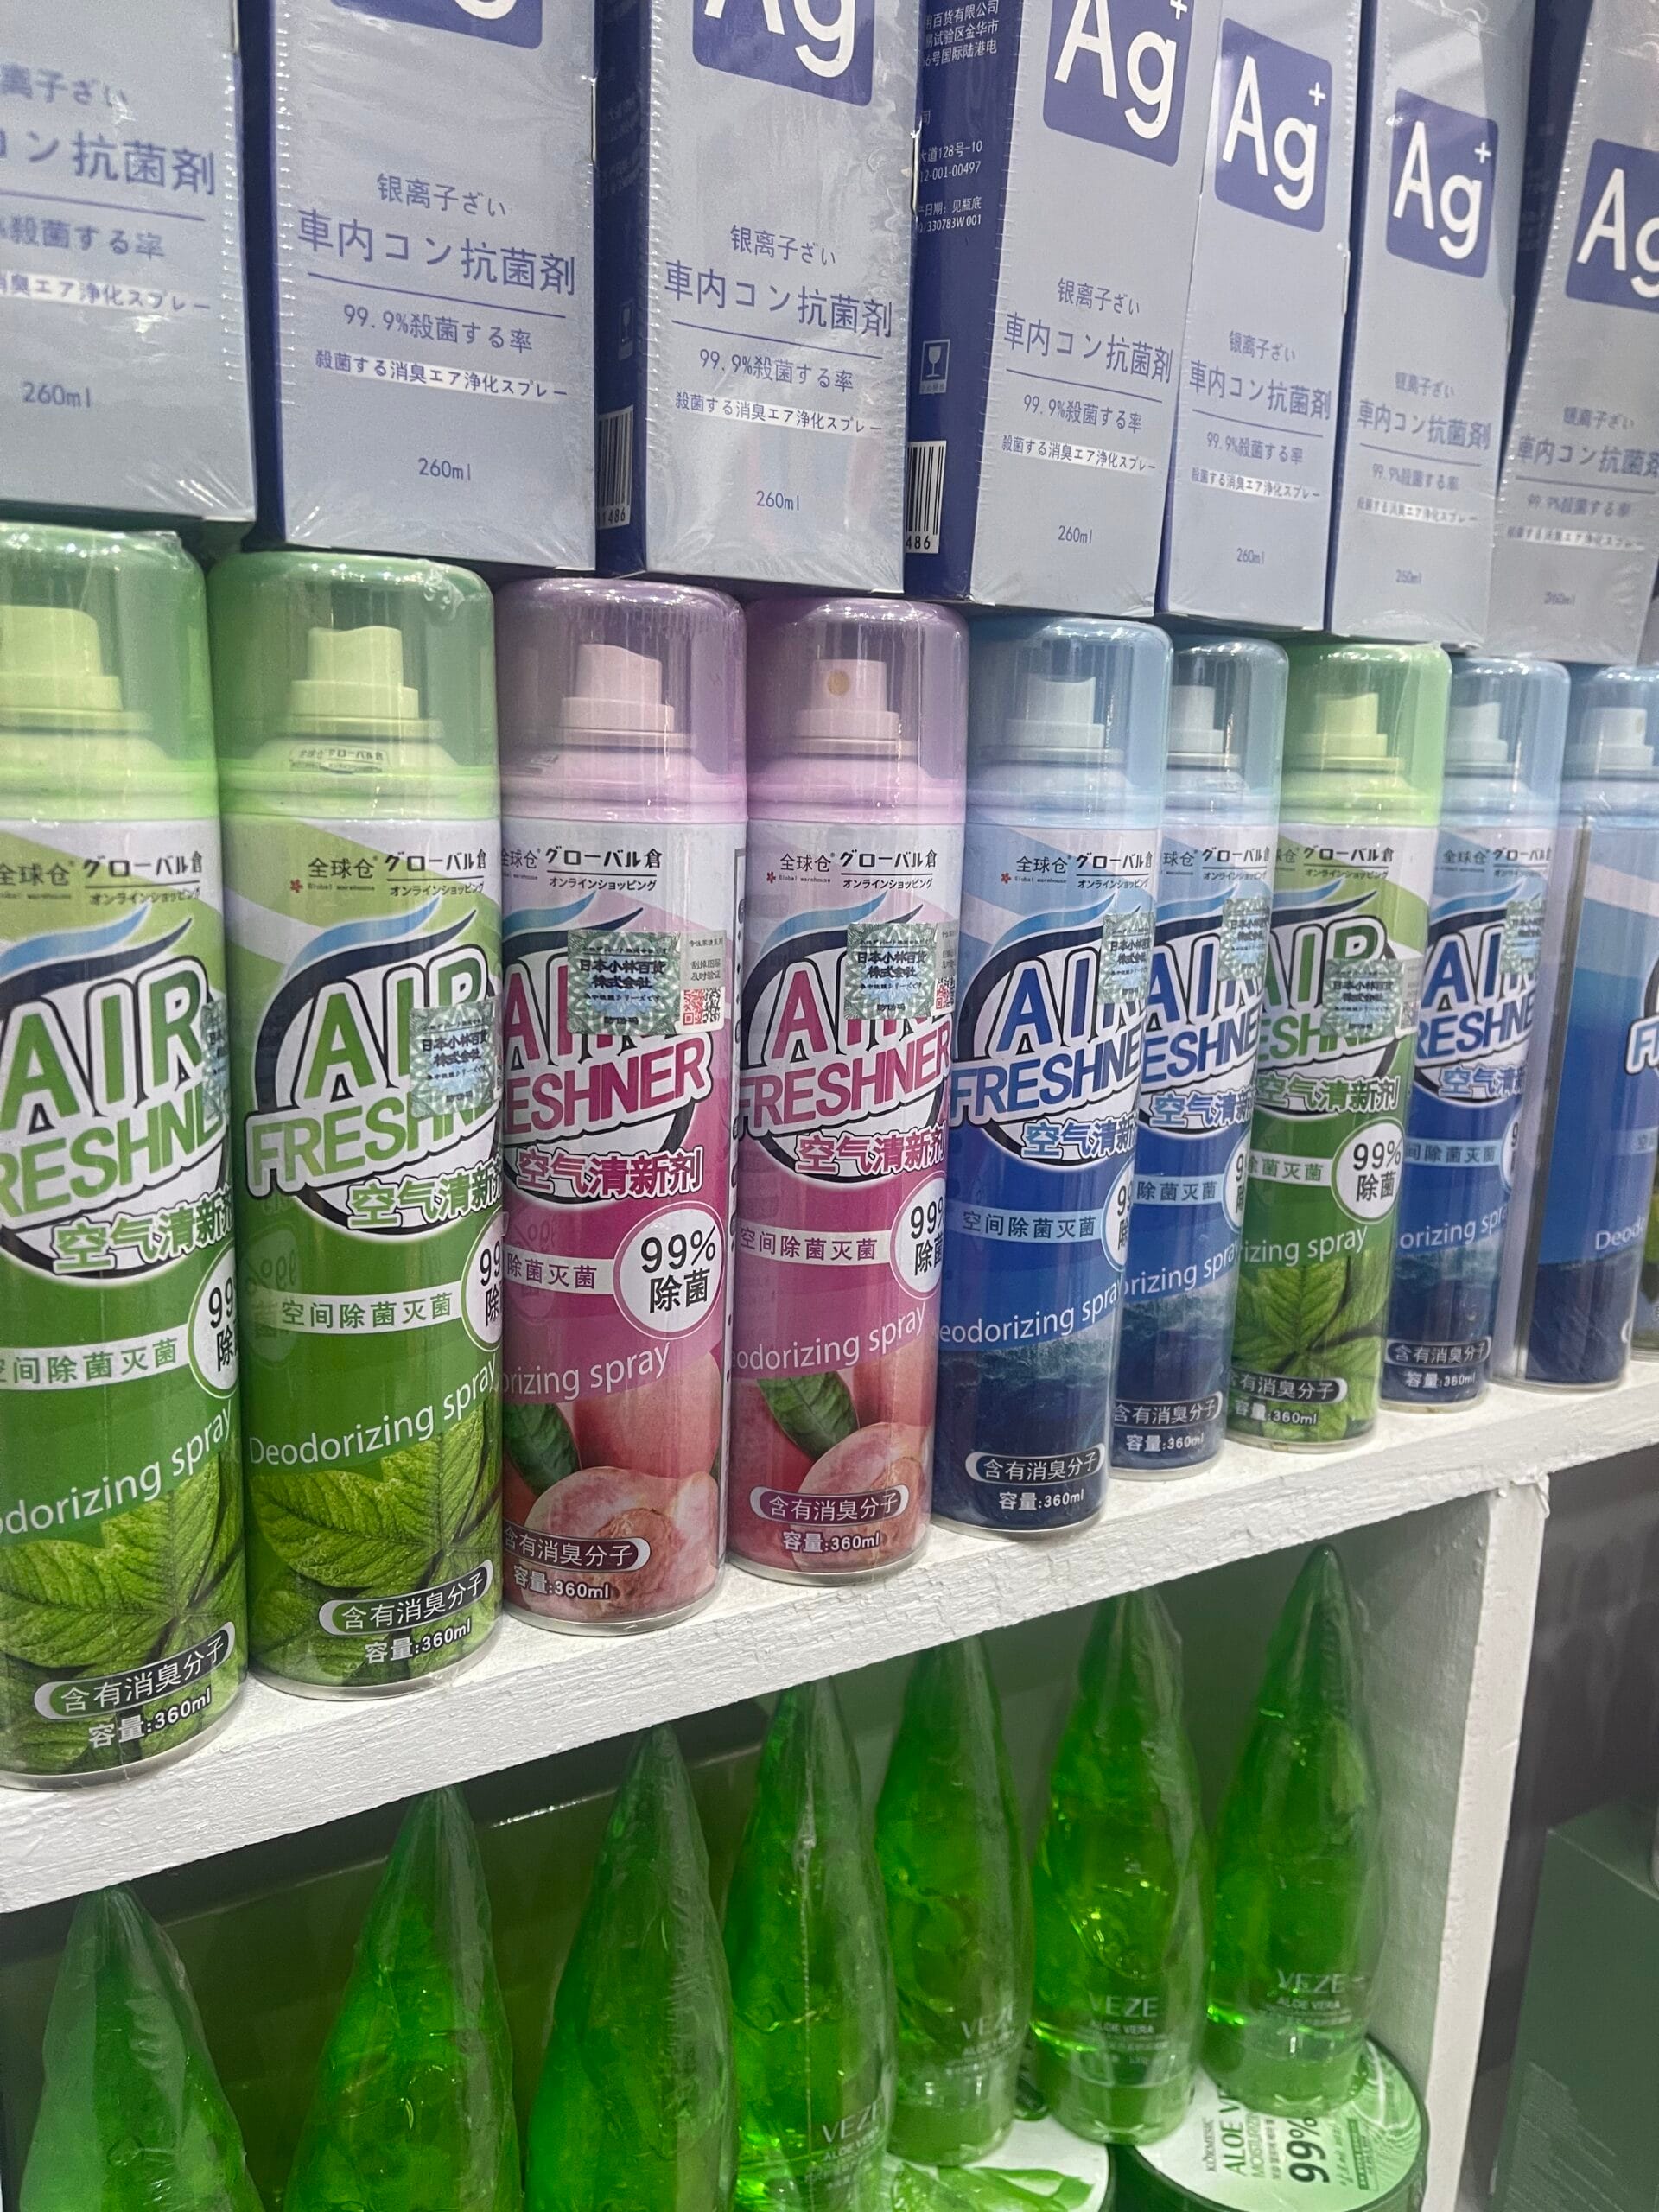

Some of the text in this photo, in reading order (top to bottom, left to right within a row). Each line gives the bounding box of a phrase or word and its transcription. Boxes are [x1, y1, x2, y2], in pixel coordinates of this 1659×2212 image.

[0, 131, 216, 196] ン抗菌剤
[377, 173, 506, 218] 银离子ざい
[298, 209, 576, 296] 車内コン抗菌剤
[730, 225, 836, 265] 银离子ざい
[664, 260, 893, 338] 車内コン抗菌剤
[1058, 277, 1140, 315] 银离子ざい
[1004, 312, 1173, 384] 車内コン抗菌剤
[315, 351, 568, 397] 殺菌する消臭エア浄化スプレー
[1190, 360, 1332, 420] 車内コン抗菌剤
[23, 382, 92, 408] 260ml
[675, 391, 882, 434] 殺菌する消臭エア浄化スプレー
[418, 458, 472, 482] 260ml
[756, 491, 800, 511] 260ml
[906, 536, 931, 550] 486
[1058, 525, 1092, 544] 260ml
[308, 857, 374, 880] 全球仓
[385, 849, 486, 873] グローバル倉
[546, 847, 662, 868] グローバル倉
[780, 853, 831, 873] 全球仓
[840, 849, 938, 868] グローバル倉
[1016, 856, 1068, 874] 全球仓
[1304, 847, 1394, 862] グローバル倉
[550, 877, 657, 891] オンラインショッピング
[2, 969, 202, 1132] AIR
[1255, 1076, 1400, 1112] 空气清新剂
[796, 1130, 947, 1173] 空气清新剂
[1352, 1140, 1402, 1170] 99%
[518, 1147, 702, 1198] 空气清新剂
[1137, 1180, 1217, 1202] 除菌灭菌
[1357, 1170, 1396, 1202] 除菌
[349, 1158, 502, 1228] 空气清新
[963, 1211, 1096, 1239] 空间除菌灭菌
[1307, 1224, 1368, 1262] spray
[1400, 1218, 1476, 1249] orizing
[641, 1225, 716, 1273] 99%
[741, 1227, 878, 1261] 空间除菌灭菌
[506, 1252, 598, 1289] 除菌灭菌
[485, 1287, 502, 1327] 除
[650, 1268, 709, 1313] 除菌
[282, 1293, 452, 1329] 空间除菌灭菌
[868, 1302, 926, 1354] spray
[590, 1342, 671, 1389] spray
[249, 1352, 497, 1465] Deodorizing spray
[1114, 1401, 1219, 1426] 含有消臭分子
[172, 1401, 234, 1478] spray
[983, 1450, 1098, 1481] 含有消臭分子
[768, 1494, 899, 1522] 含有消臭分子
[504, 1524, 633, 1567] 含有消臭分子
[341, 1572, 484, 1630] 含有消臭分子
[60, 1636, 226, 1713] 含有消臭分子
[1277, 1970, 1347, 1993] VEZE
[1089, 1992, 1159, 2018] VEZE
[1219, 2120, 1247, 2177] ALOE
[1286, 2112, 1331, 2183] 99%
